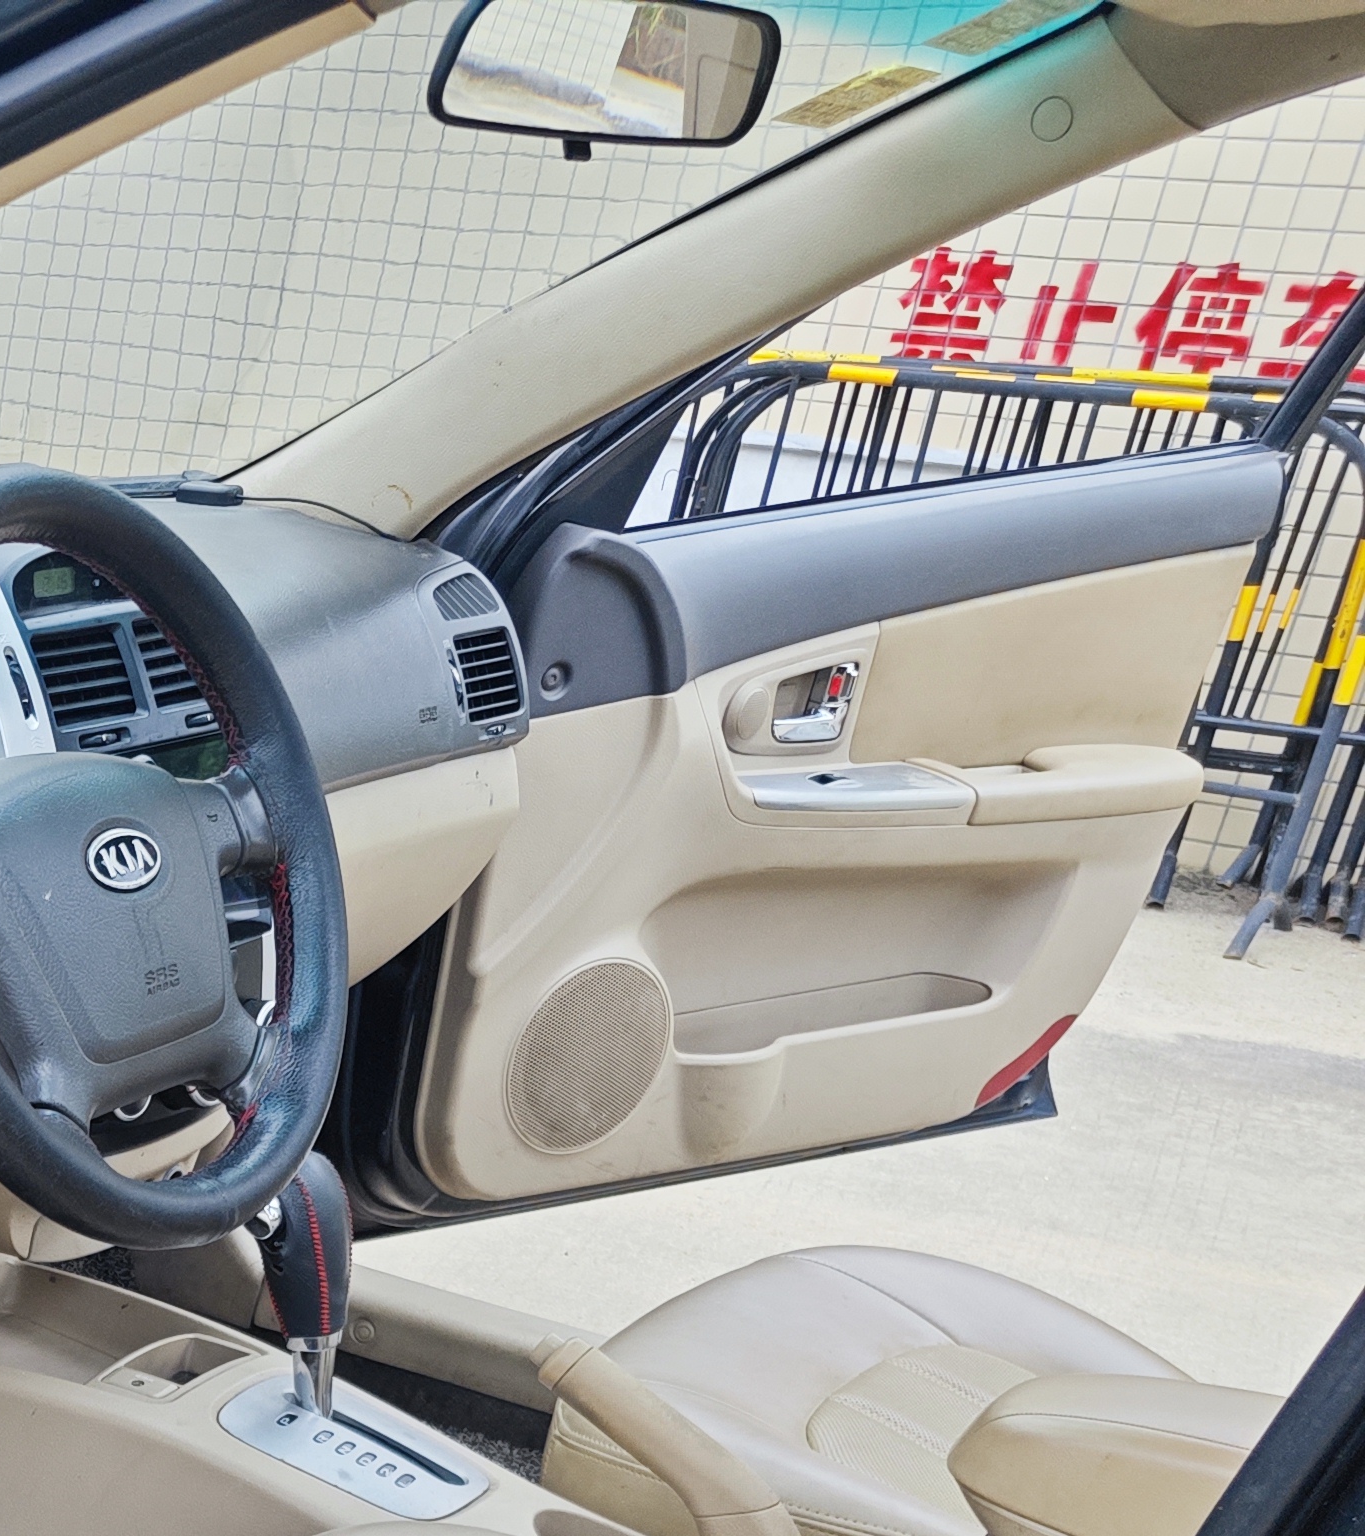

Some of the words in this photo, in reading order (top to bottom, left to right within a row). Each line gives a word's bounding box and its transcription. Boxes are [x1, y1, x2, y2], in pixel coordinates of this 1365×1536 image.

[98, 839, 155, 879] KIA
[144, 963, 179, 985] SRS
[147, 978, 180, 996] AIRBAG
